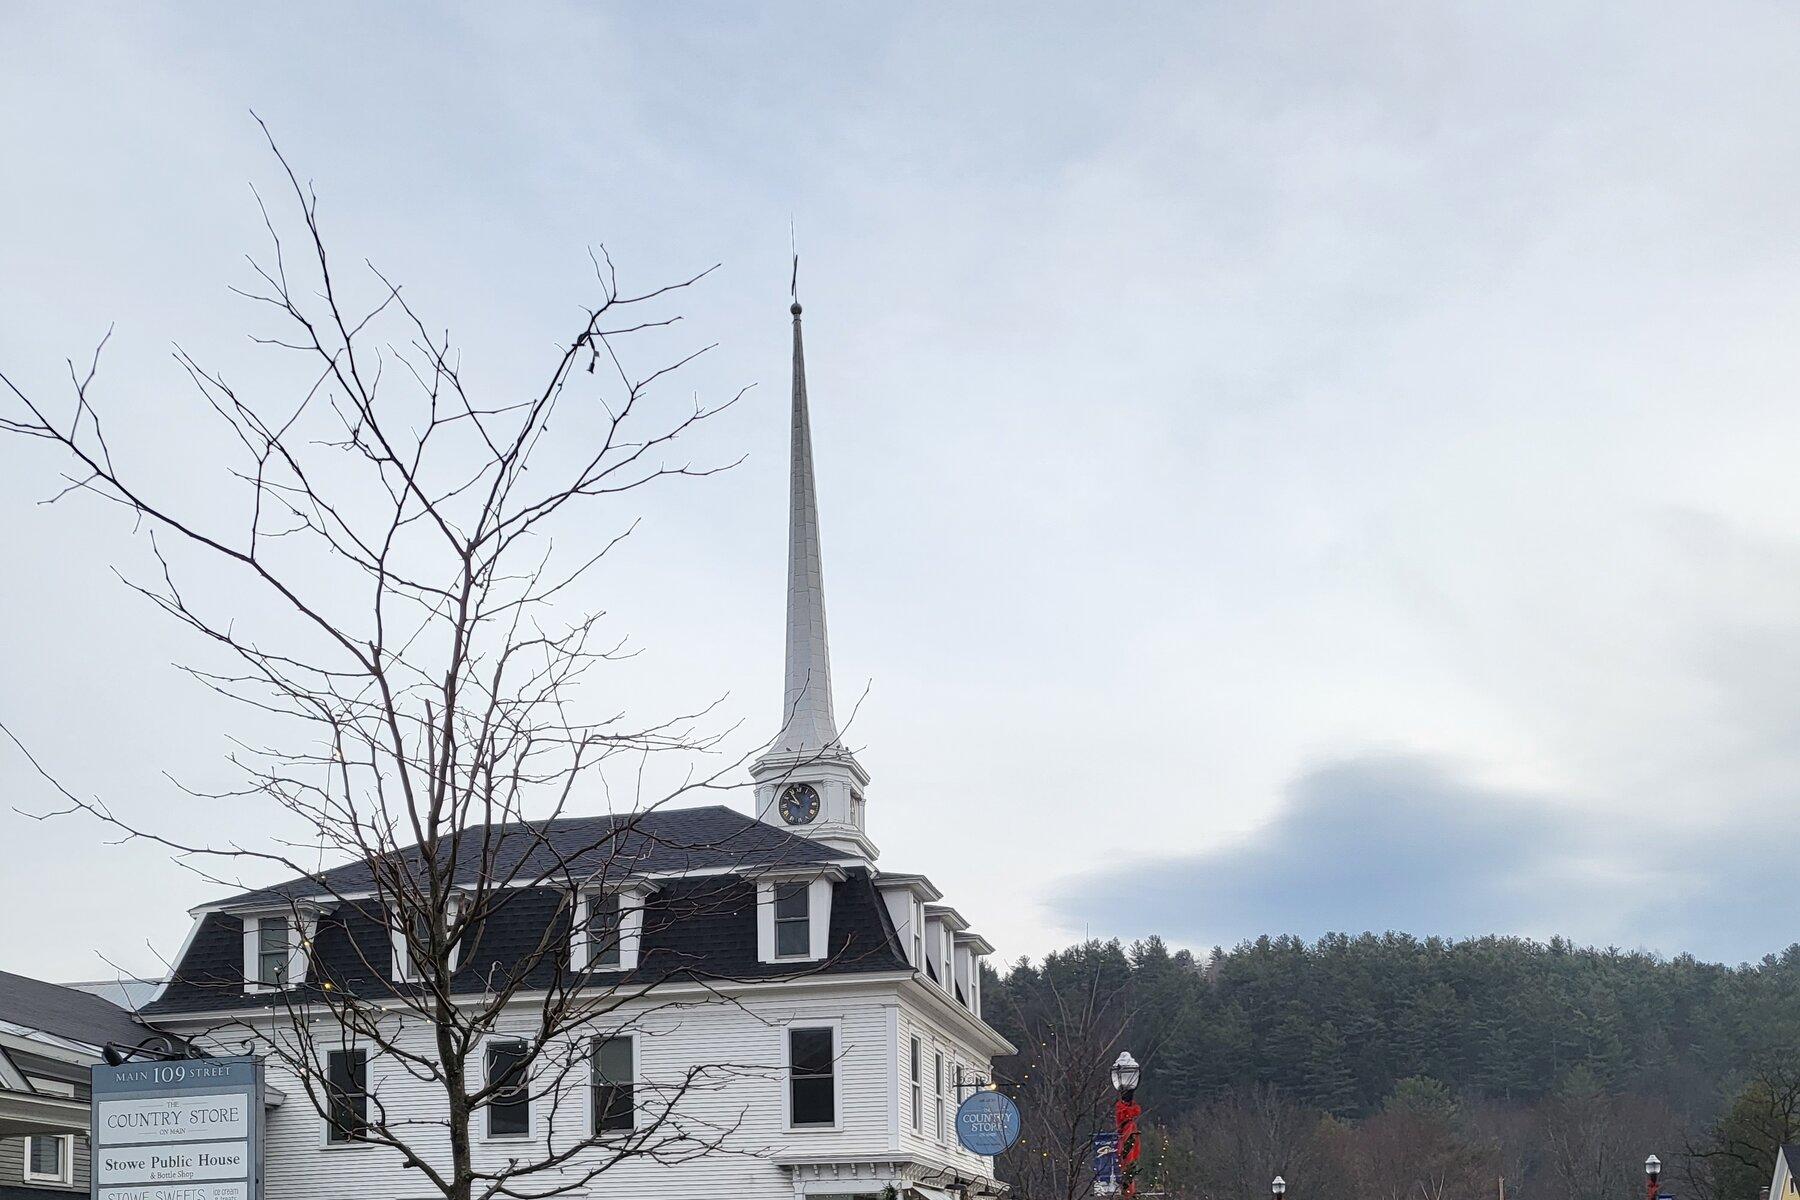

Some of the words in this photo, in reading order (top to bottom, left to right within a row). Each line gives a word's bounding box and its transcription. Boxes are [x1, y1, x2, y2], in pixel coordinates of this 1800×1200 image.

[116, 1071, 148, 1082] MAIN
[153, 1066, 186, 1083] 109
[189, 1066, 231, 1078] STREET
[107, 1111, 182, 1128] COUNTRY
[189, 1107, 239, 1124] STORE
[105, 1158, 145, 1171] Stowe
[151, 1155, 193, 1169] Public
[198, 1153, 240, 1166] House
[150, 1172, 156, 1180] &
[157, 1171, 176, 1179] Bottle
[177, 1170, 194, 1179] Shop
[221, 1187, 239, 1195] cream
